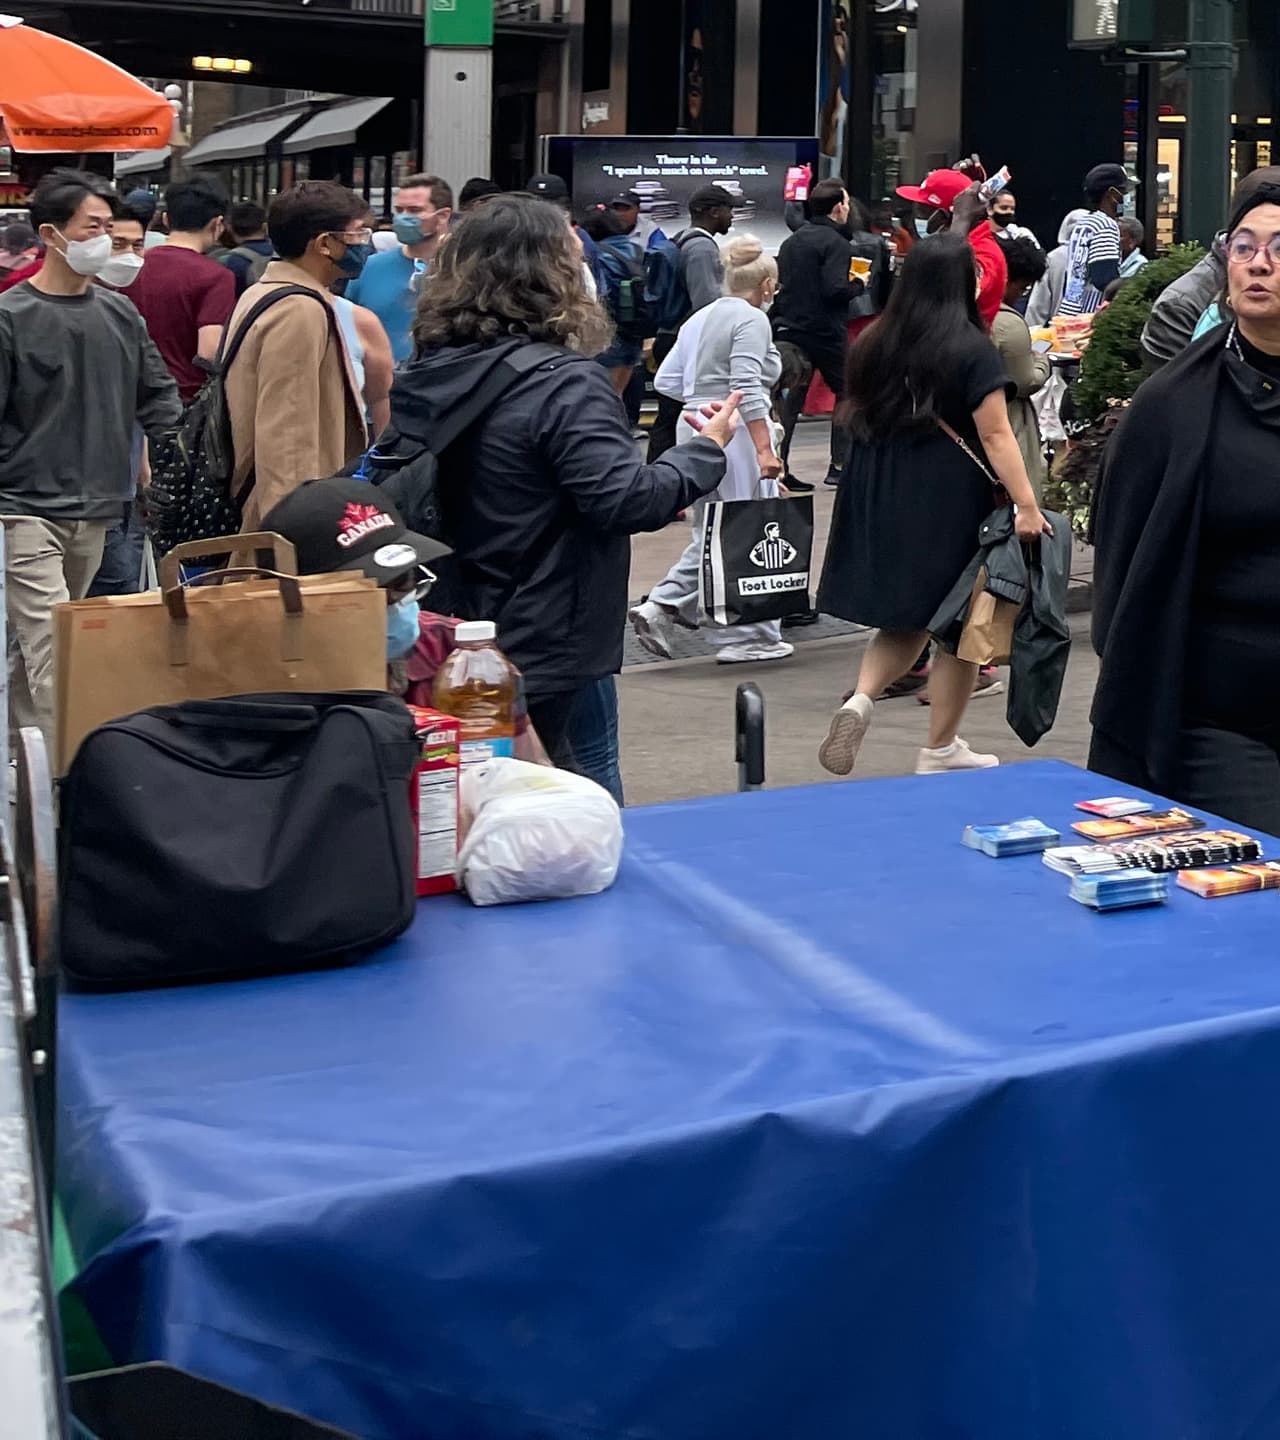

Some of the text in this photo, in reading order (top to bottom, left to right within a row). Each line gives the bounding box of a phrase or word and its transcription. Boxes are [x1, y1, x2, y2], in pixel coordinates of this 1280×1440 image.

[336, 513, 396, 547] CANADA
[742, 575, 806, 592] Foot Locker
